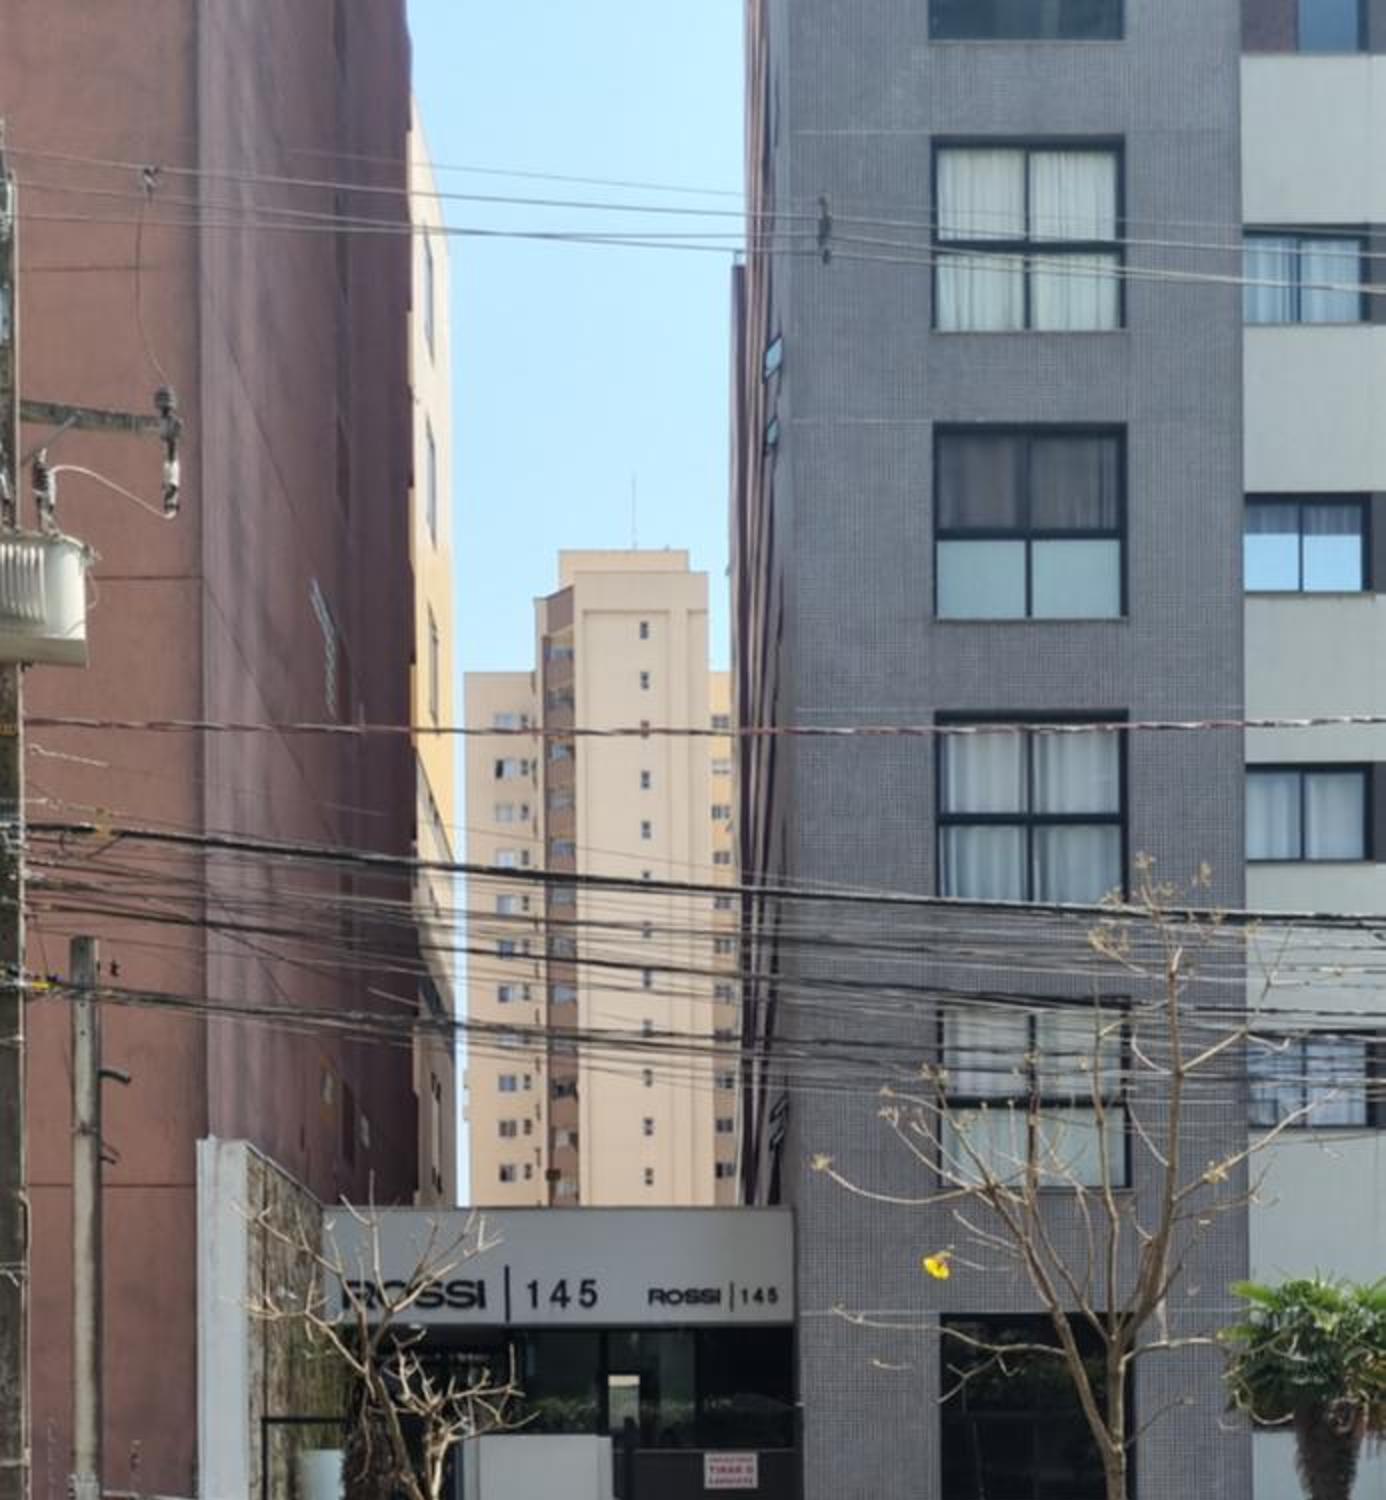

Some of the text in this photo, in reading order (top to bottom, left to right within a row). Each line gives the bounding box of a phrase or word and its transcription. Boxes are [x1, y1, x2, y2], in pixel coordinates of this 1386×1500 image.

[342, 1279, 598, 1309] ROSSI 145
[648, 1286, 779, 1305] ROSSI 145
